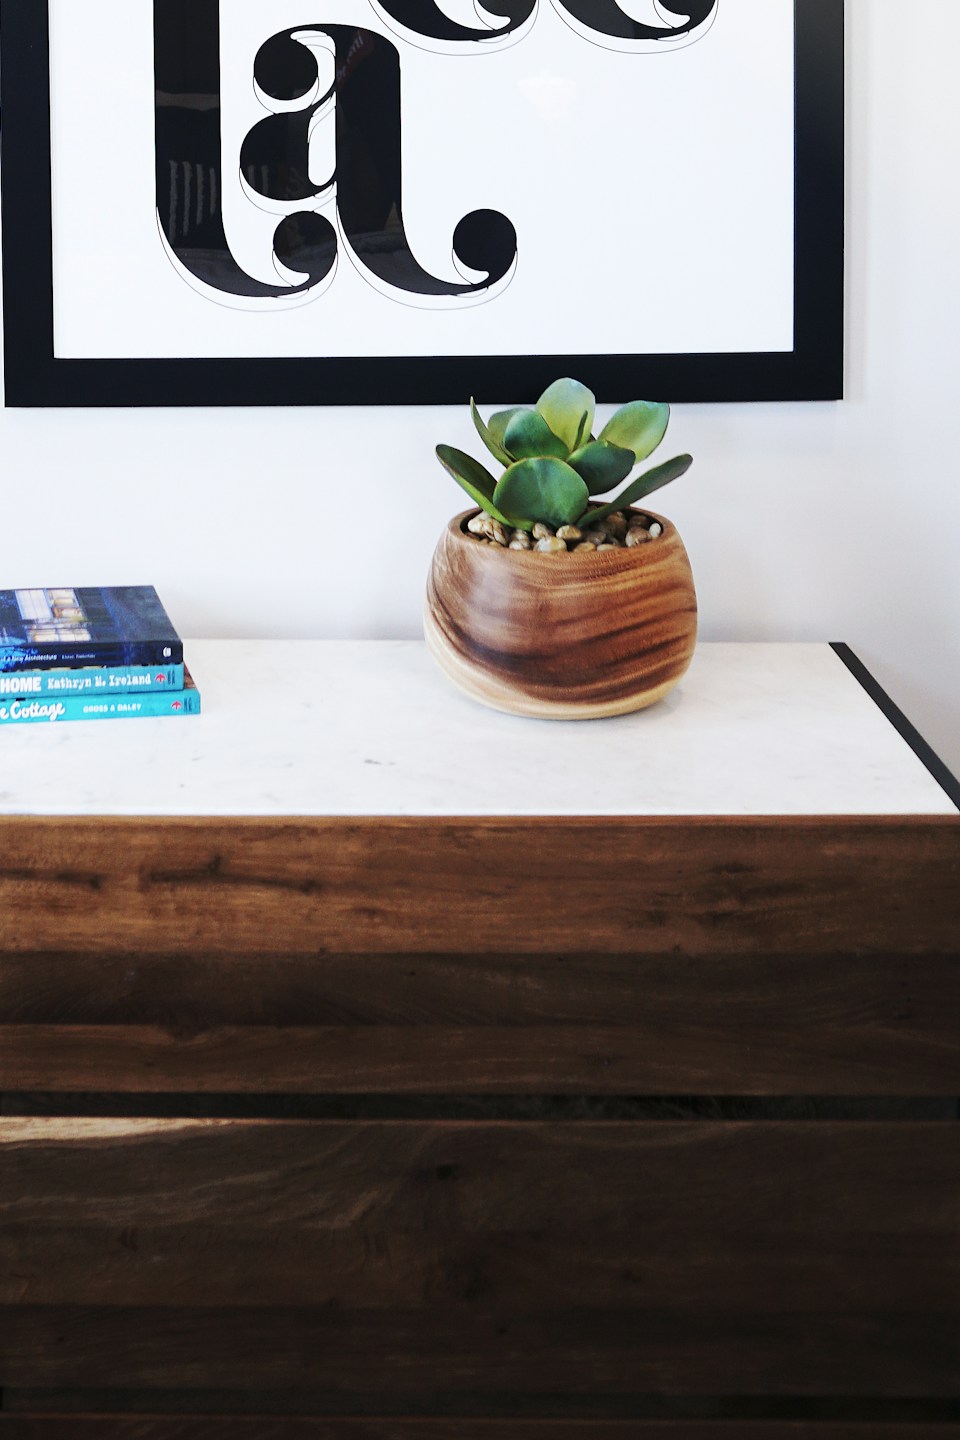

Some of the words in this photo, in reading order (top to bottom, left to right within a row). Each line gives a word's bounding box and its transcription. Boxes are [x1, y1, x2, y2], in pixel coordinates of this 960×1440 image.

[0, 676, 42, 693] HOME
[48, 677, 91, 689] Kathryn
[95, 675, 106, 687] M.
[109, 673, 151, 686] Ireland
[10, 701, 65, 721] Cottage
